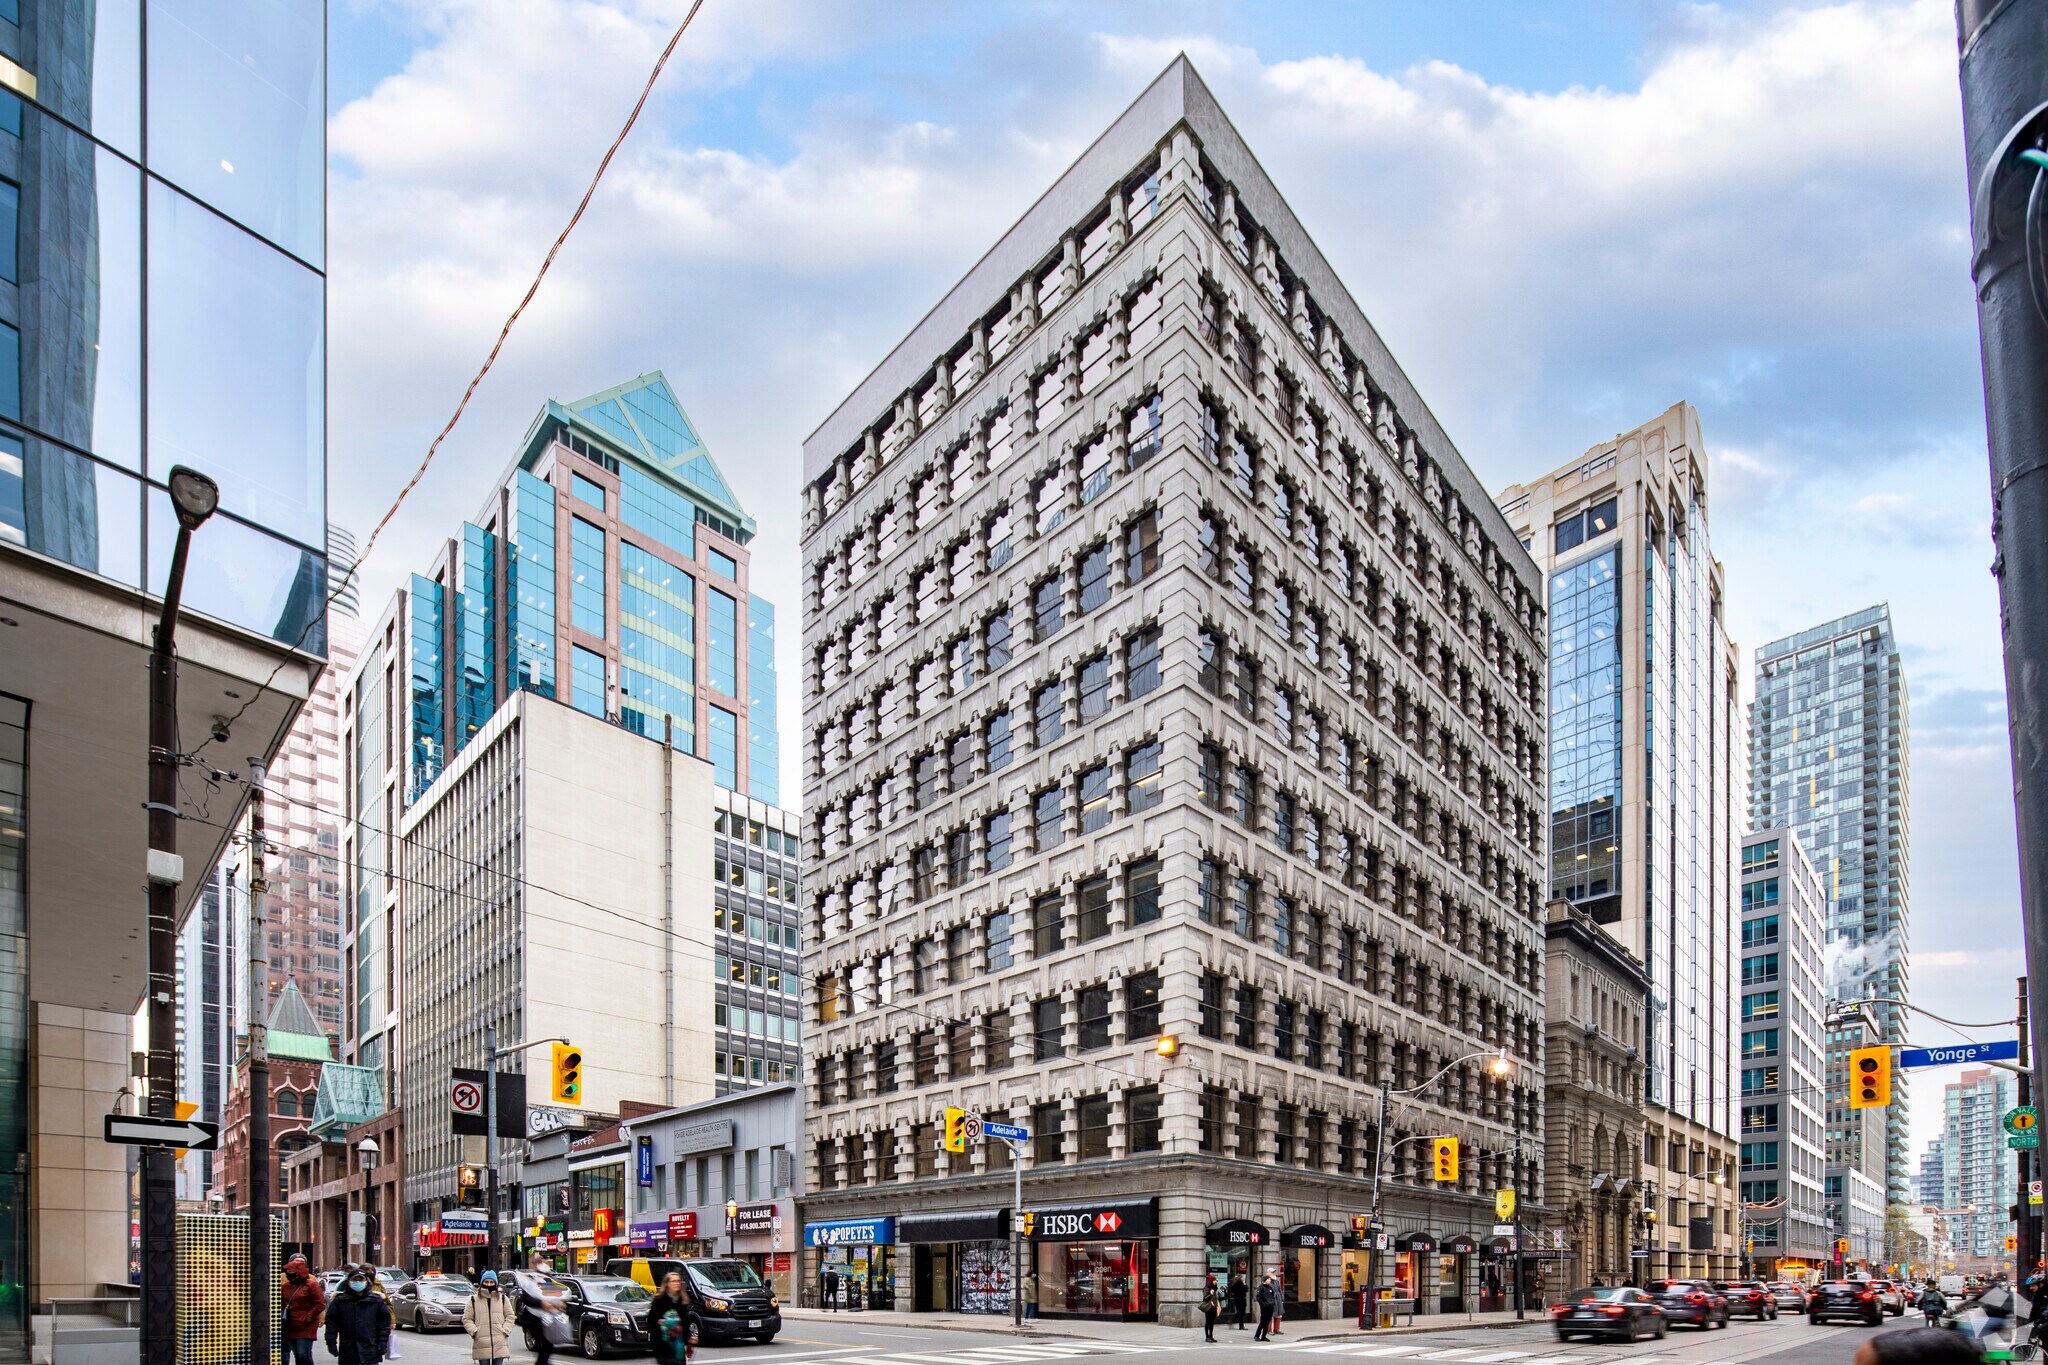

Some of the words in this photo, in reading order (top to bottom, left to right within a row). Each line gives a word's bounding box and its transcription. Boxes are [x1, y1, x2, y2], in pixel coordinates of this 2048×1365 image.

[1927, 1048, 1977, 1063] Yonge
[1980, 1044, 1990, 1052] St
[2004, 1110, 2017, 1123] DON
[991, 1124, 1018, 1137] Adelaide
[2010, 1137, 2037, 1148] NORTH
[672, 1214, 690, 1222] NOVELTY
[740, 1211, 751, 1220] FOR
[752, 1210, 771, 1219] LEASE
[444, 1220, 472, 1229] Adelaide
[1042, 1213, 1092, 1235] HSBC
[567, 1229, 595, 1239] McDonald's
[835, 1225, 875, 1241] POPEYE'S
[1230, 1231, 1250, 1243] HSBC
[1301, 1235, 1318, 1246] HSBC
[1412, 1242, 1425, 1251] HSBC
[1455, 1244, 1467, 1252] HSBC
[1094, 1266, 1112, 1274] open
